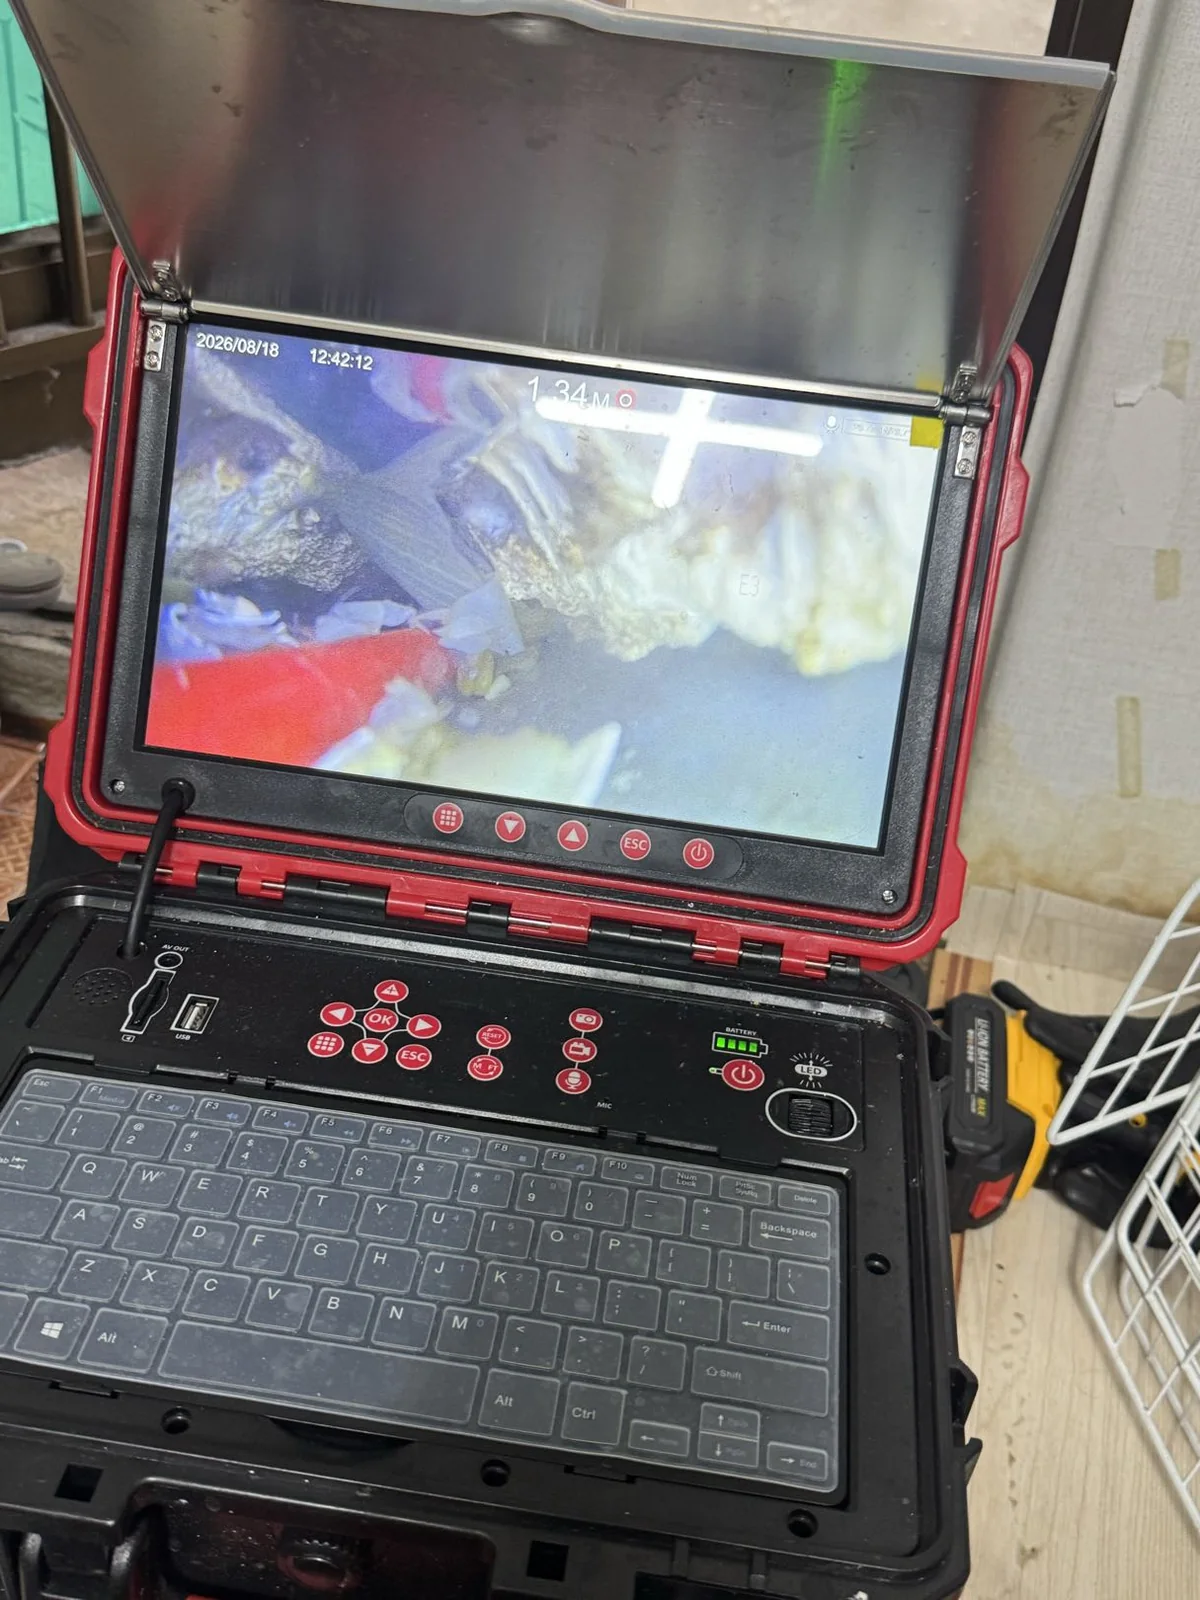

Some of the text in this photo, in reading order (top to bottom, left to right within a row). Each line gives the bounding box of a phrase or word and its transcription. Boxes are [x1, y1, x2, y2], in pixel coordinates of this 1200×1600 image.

[196, 332, 374, 371] 2026/08/18 12:42:12
[624, 838, 648, 851] ESC
[368, 1012, 391, 1025] OK
[175, 1033, 191, 1041] USB
[726, 1027, 757, 1036] BATTERY
[401, 1050, 426, 1062] ESC
[800, 1066, 822, 1076] LED
[33, 1079, 50, 1087] Esc
[90, 1086, 104, 1094] F1
[148, 1094, 163, 1102] F2
[205, 1101, 220, 1110] F3
[263, 1109, 277, 1118] F4
[133, 1122, 145, 1131] @
[321, 1117, 335, 1126] F5
[379, 1126, 393, 1135] F6
[126, 1135, 136, 1144] 2
[436, 1134, 451, 1143] F7
[184, 1143, 193, 1152] 3
[494, 1143, 508, 1152] F8
[241, 1151, 249, 1160] 4
[552, 1152, 566, 1160] F9
[82, 1162, 97, 1174] Q
[298, 1159, 307, 1168] 5
[608, 1160, 628, 1170] F10
[141, 1169, 159, 1182] W
[355, 1167, 364, 1176] 6
[677, 1172, 697, 1181] Num
[197, 1178, 211, 1189] E
[413, 1176, 422, 1185] 7
[676, 1179, 696, 1187] Lock
[255, 1186, 269, 1198] R
[470, 1184, 479, 1193] 8
[317, 1194, 329, 1207] T
[527, 1193, 536, 1201] 9
[73, 1208, 86, 1221] A
[376, 1203, 388, 1215] Y
[133, 1217, 146, 1229] S
[432, 1212, 445, 1224] U
[192, 1225, 207, 1238] D
[760, 1221, 818, 1239] Backspace
[252, 1234, 266, 1247] F
[608, 1238, 621, 1250] P
[313, 1243, 329, 1256] G
[373, 1252, 387, 1265] H
[80, 1259, 95, 1272] Z
[434, 1262, 445, 1274] J
[141, 1268, 157, 1282] X
[494, 1271, 506, 1284] K
[203, 1278, 218, 1291] C
[555, 1280, 565, 1293] L
[267, 1287, 281, 1300] V
[327, 1297, 340, 1310] B
[389, 1306, 404, 1319] N
[452, 1316, 468, 1330] M
[763, 1322, 792, 1334] Enter
[97, 1331, 117, 1344] Alt
[719, 1370, 742, 1381] Shift
[495, 1394, 513, 1408] Alt
[571, 1407, 596, 1420] Ctrl
